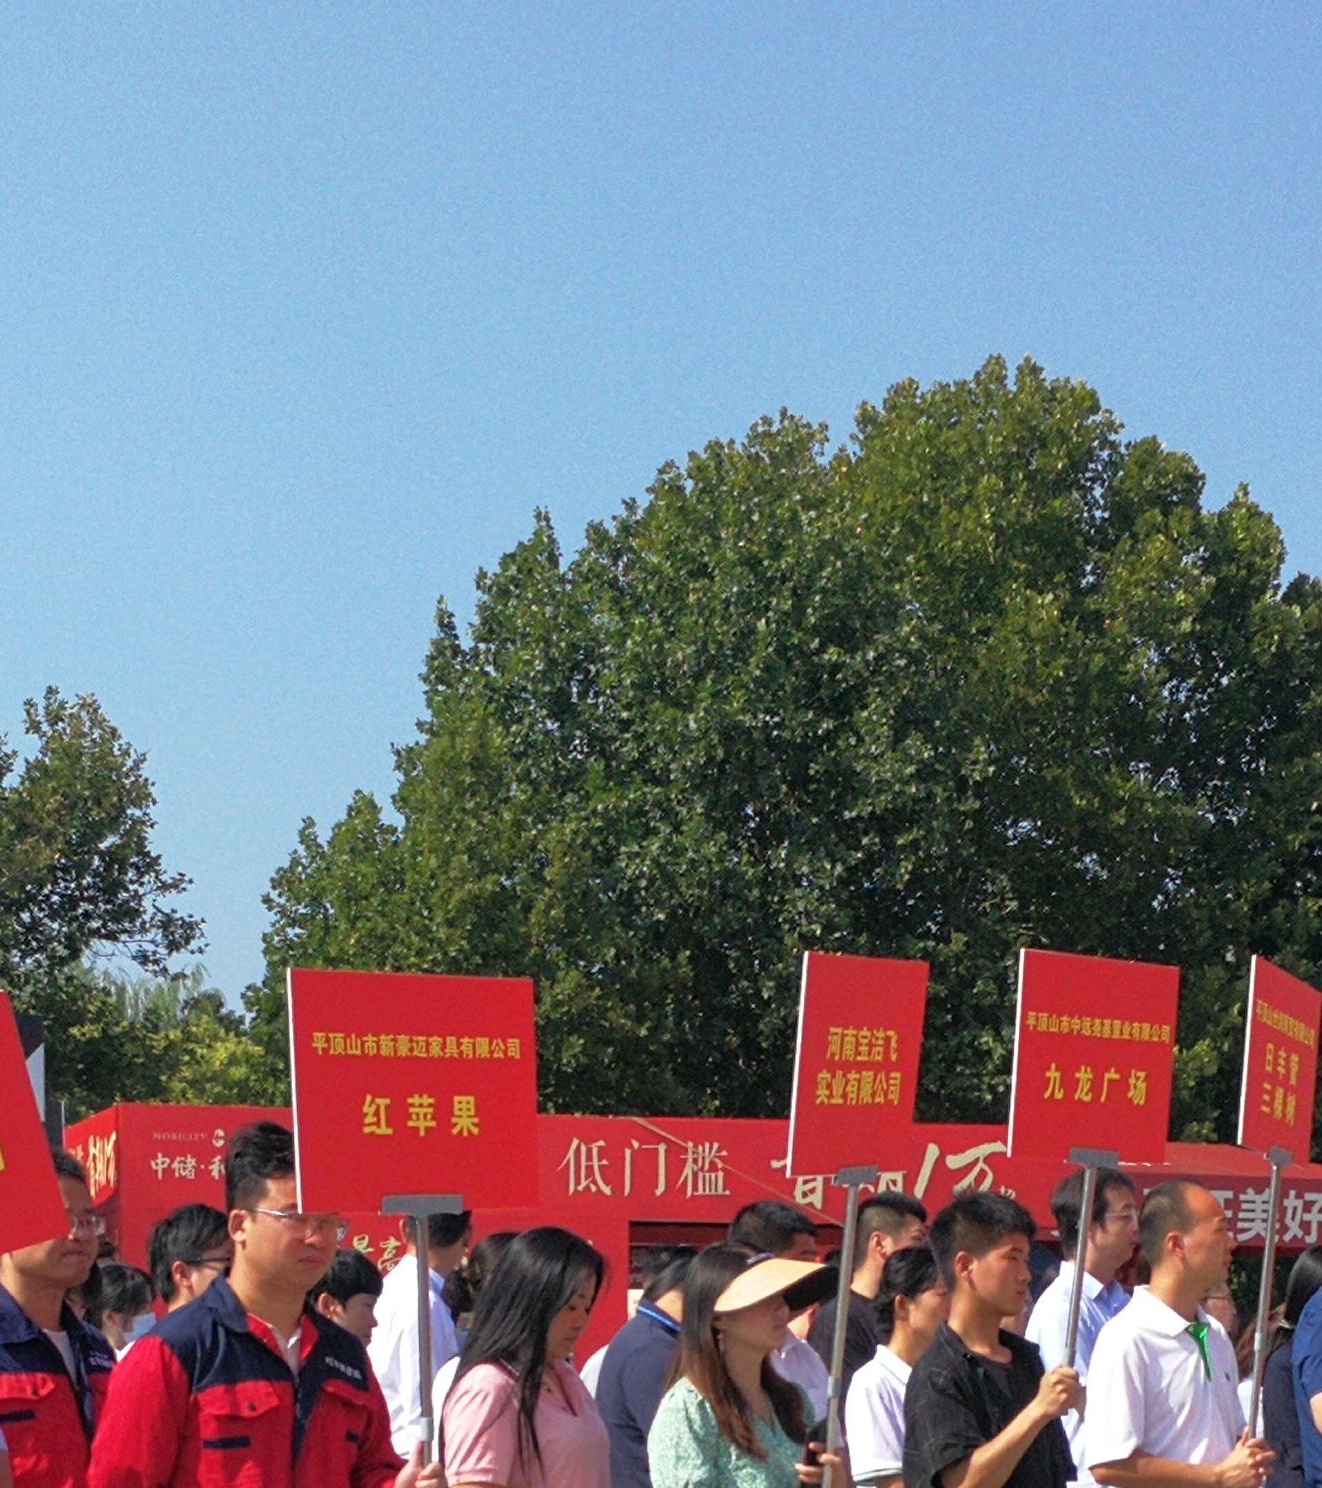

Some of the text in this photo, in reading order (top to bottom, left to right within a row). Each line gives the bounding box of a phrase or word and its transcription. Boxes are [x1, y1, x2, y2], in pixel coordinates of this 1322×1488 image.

[311, 1032, 521, 1060] 平顶山市新豪迈家具有限公司
[826, 1026, 899, 1062] 河南宝洁飞
[815, 1069, 902, 1106] 实业有限公司
[1044, 1062, 1148, 1106] 九龙广场
[362, 1094, 480, 1137] 红苹果
[557, 1136, 730, 1198] 低门槛
